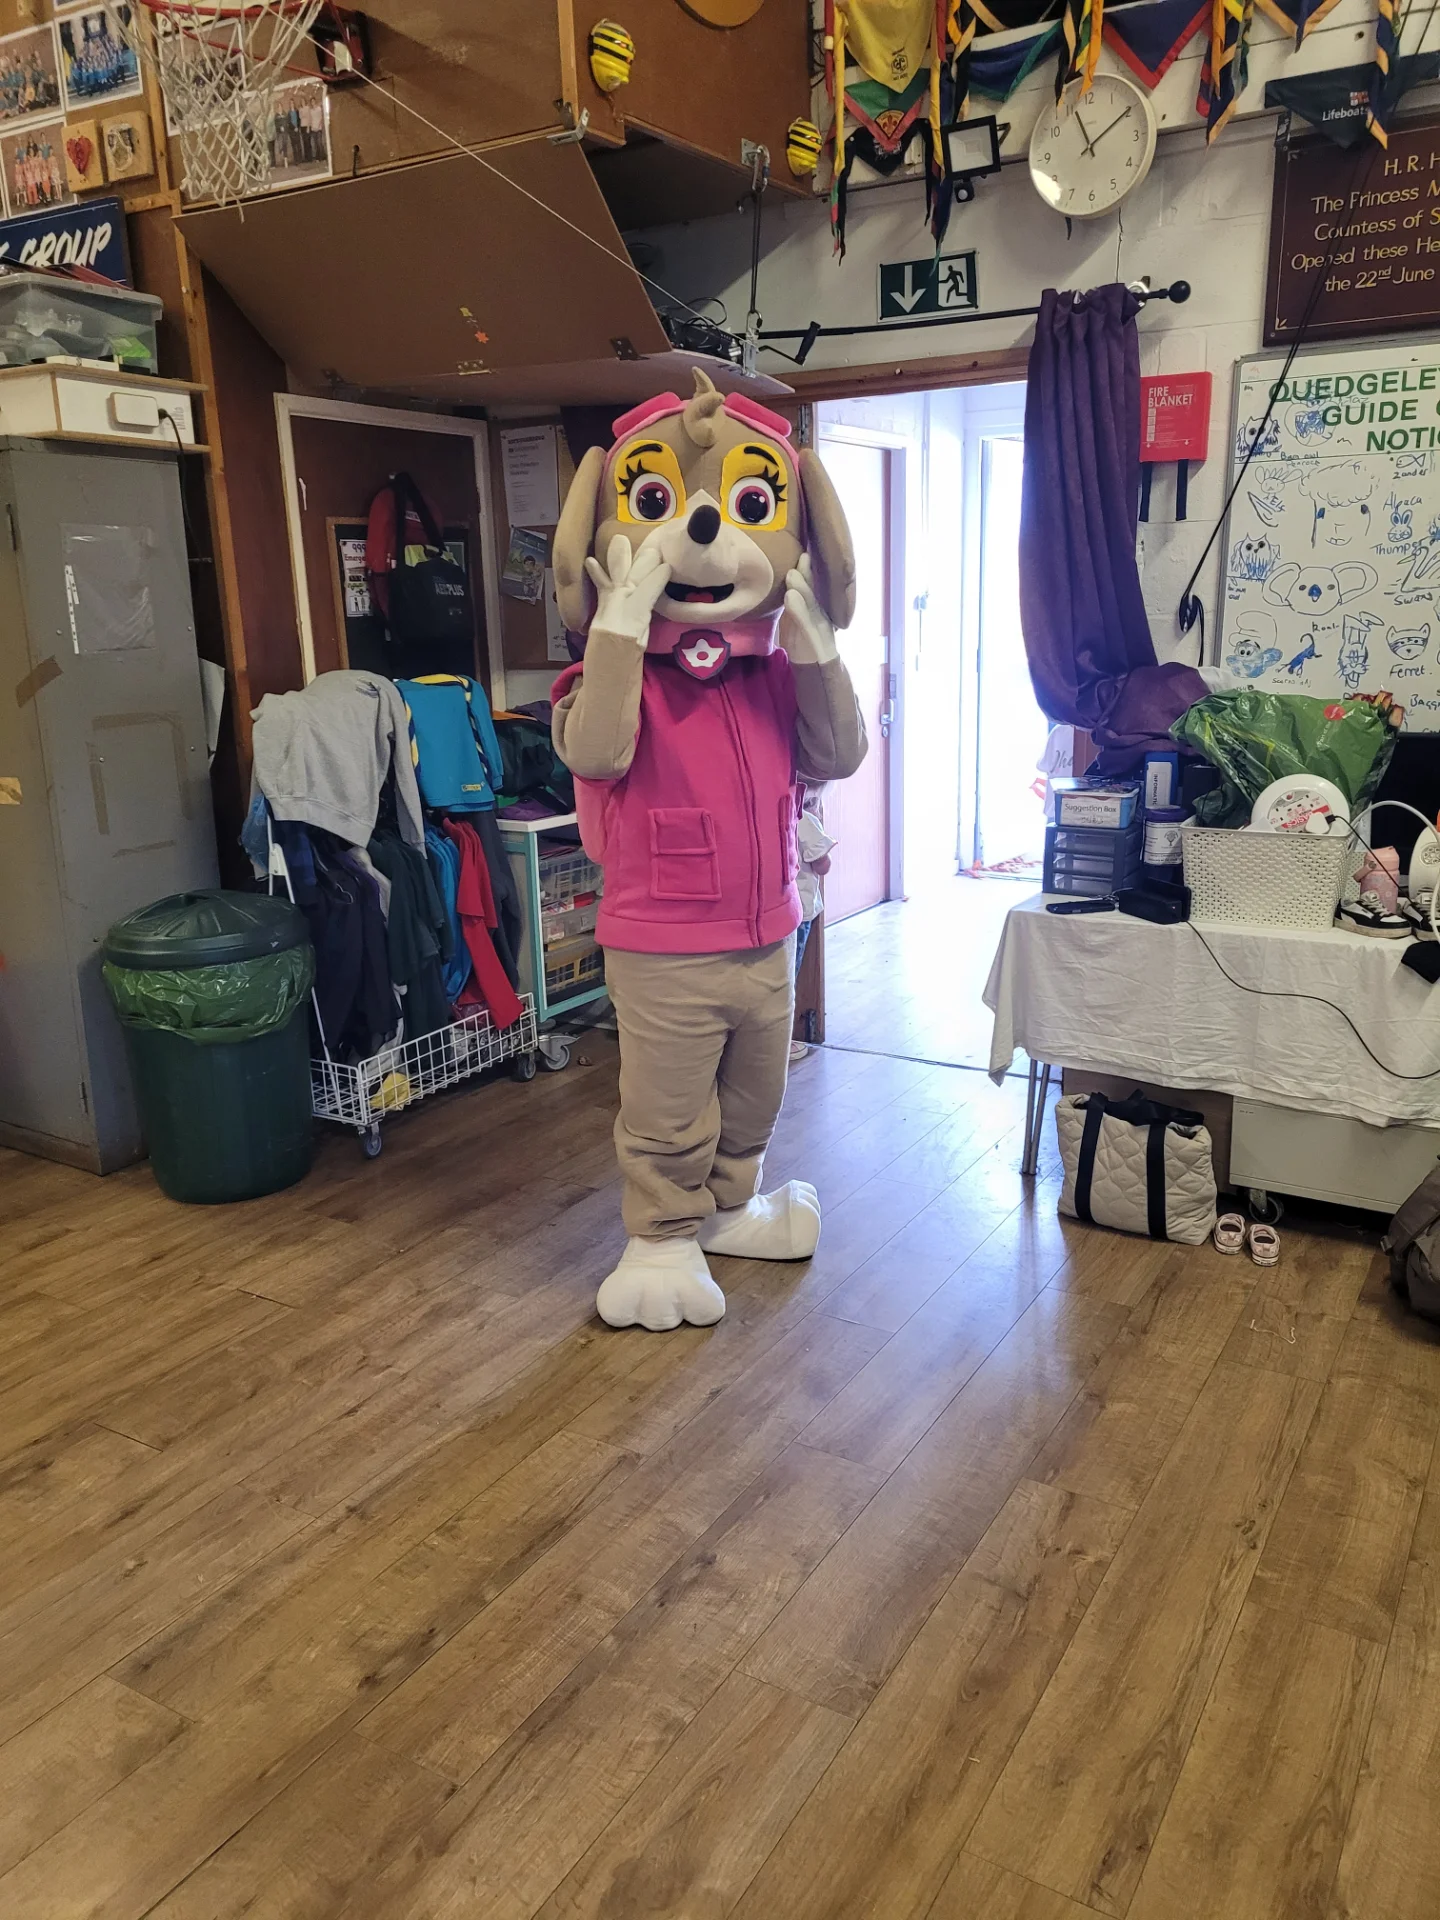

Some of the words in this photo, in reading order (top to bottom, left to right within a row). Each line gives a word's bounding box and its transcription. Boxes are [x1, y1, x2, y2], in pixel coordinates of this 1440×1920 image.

[1085, 92, 1094, 104] 12
[1051, 126, 1060, 138] 10
[1133, 130, 1139, 141] 3
[1044, 153, 1051, 164] 9
[1126, 156, 1132, 168] 4
[1110, 179, 1117, 190] 5
[1069, 189, 1075, 200] 7
[1089, 190, 1095, 201] 6
[1311, 196, 1344, 214] The
[1314, 218, 1396, 240] Countess
[1403, 210, 1424, 229] of
[20, 222, 112, 268] GROUP
[1363, 241, 1408, 261] these
[1325, 276, 1351, 292] the
[1392, 267, 1435, 285] June
[1269, 367, 1440, 402] QUEDGELE
[1148, 386, 1169, 398] FIRE
[1148, 394, 1193, 408] BLANKET
[1322, 399, 1418, 427] GUIDE
[1366, 426, 1440, 452] NOTI
[1383, 491, 1422, 511] Alpaca
[1064, 803, 1102, 812] Suggestion
